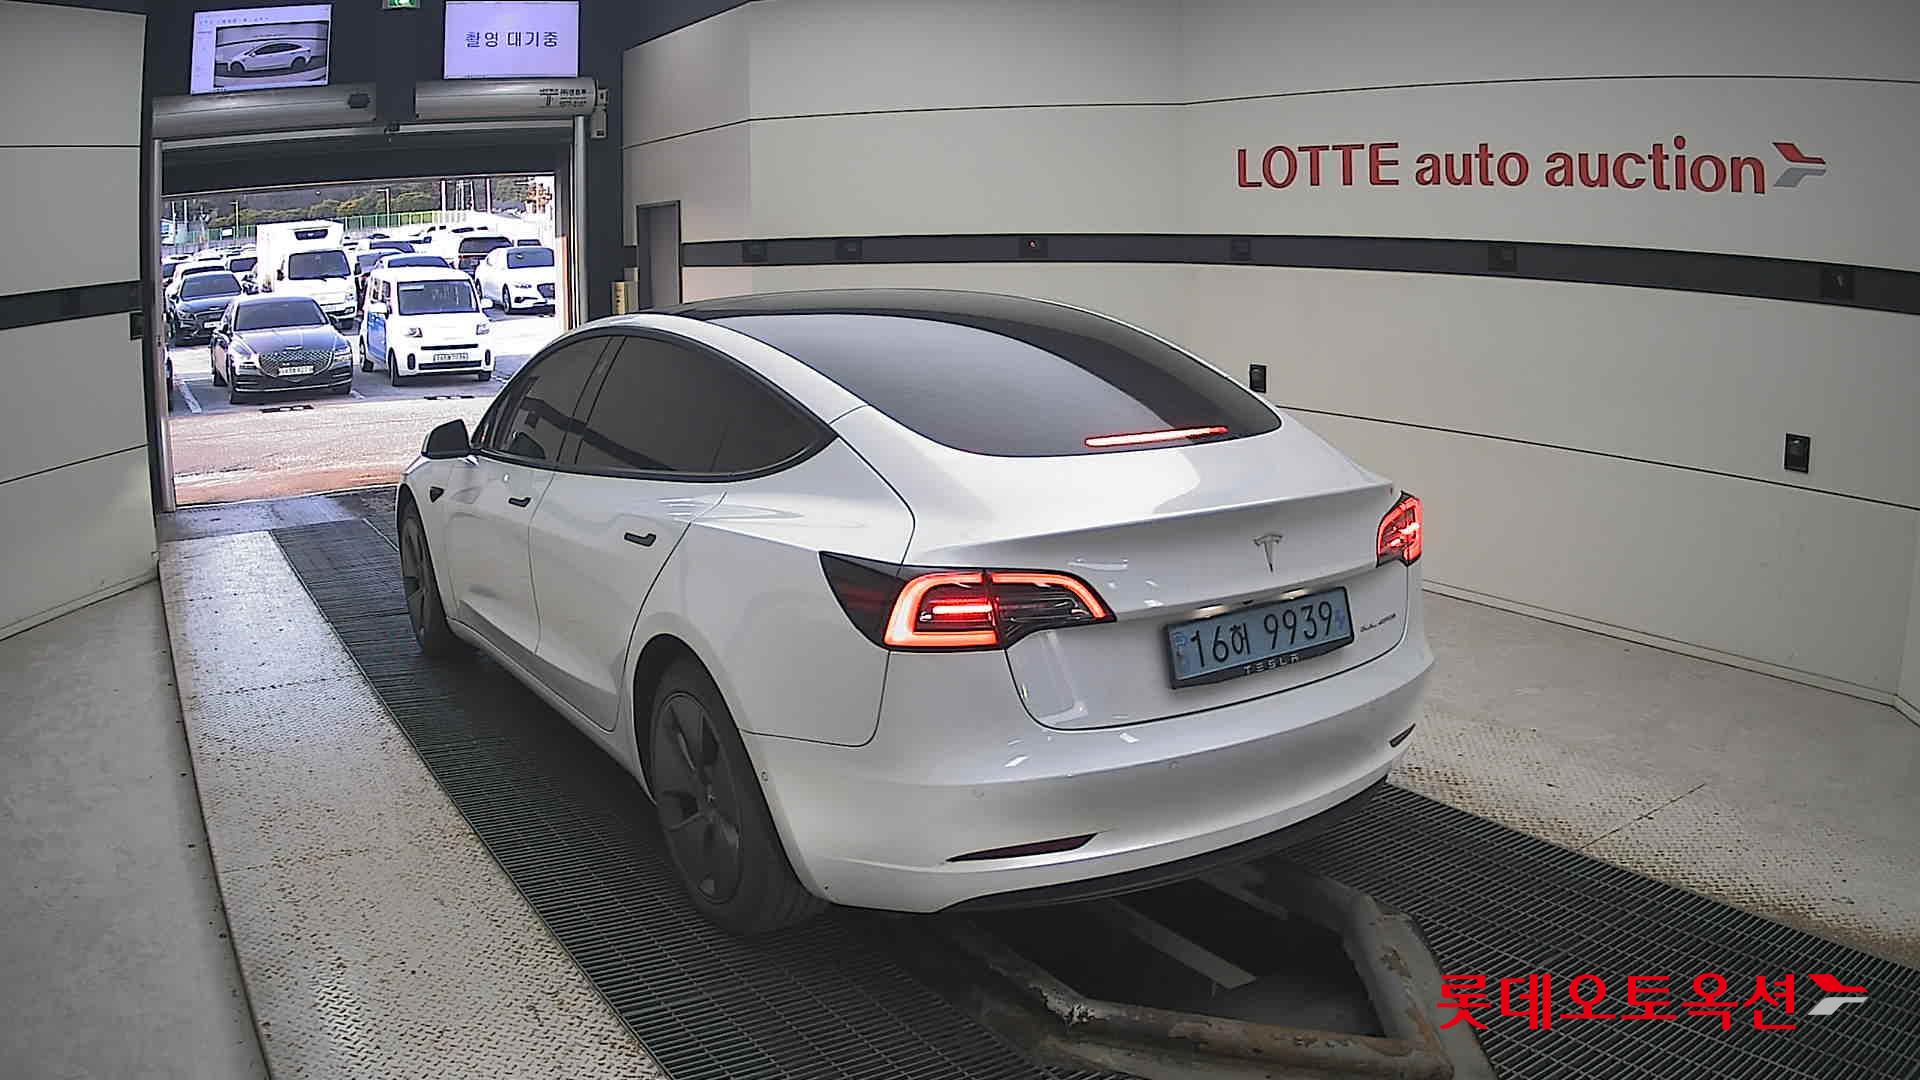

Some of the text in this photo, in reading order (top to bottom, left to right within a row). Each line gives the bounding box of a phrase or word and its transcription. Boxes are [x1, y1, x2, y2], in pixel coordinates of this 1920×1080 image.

[507, 31, 559, 48] 대기중
[1237, 136, 1766, 195] LOTTE auto auction
[1264, 600, 1333, 650] 9939
[1243, 655, 1300, 676] TESLA
